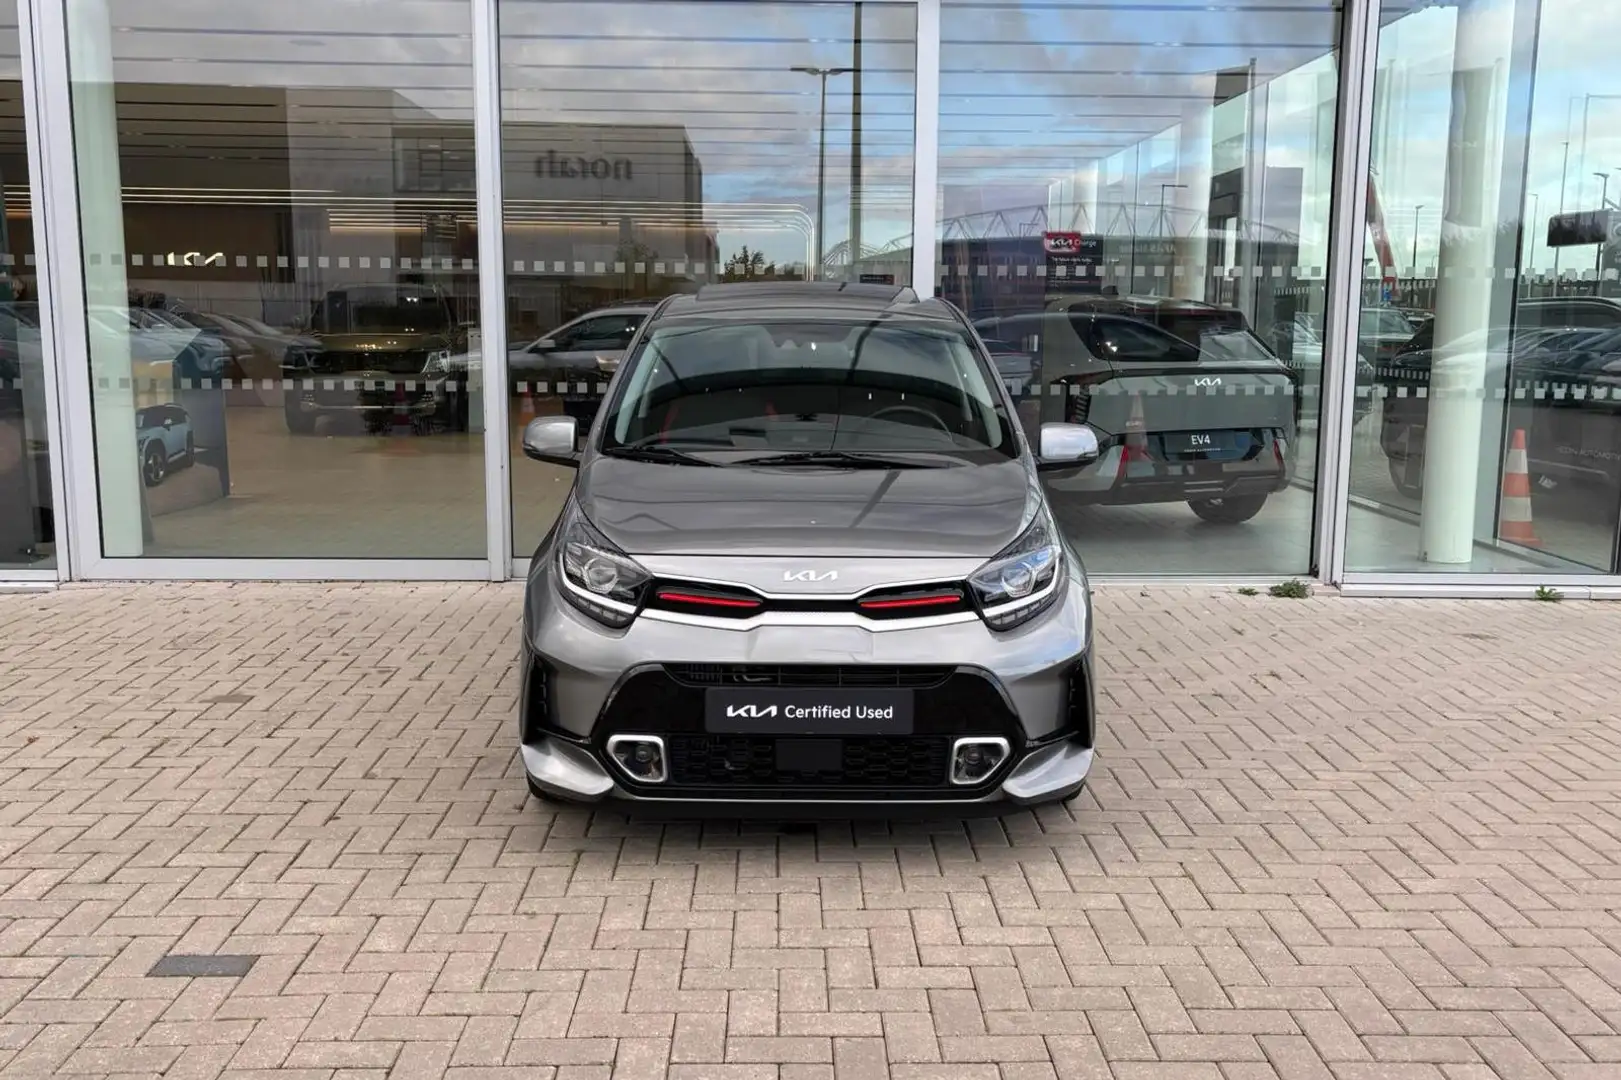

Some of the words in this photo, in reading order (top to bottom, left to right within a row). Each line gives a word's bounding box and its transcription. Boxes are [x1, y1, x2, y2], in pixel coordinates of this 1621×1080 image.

[1194, 377, 1222, 386] KIA
[1190, 434, 1211, 445] EV4
[783, 570, 838, 581] KIA
[727, 705, 778, 718] KIA
[784, 705, 851, 719] Certified
[855, 705, 893, 719] Used
